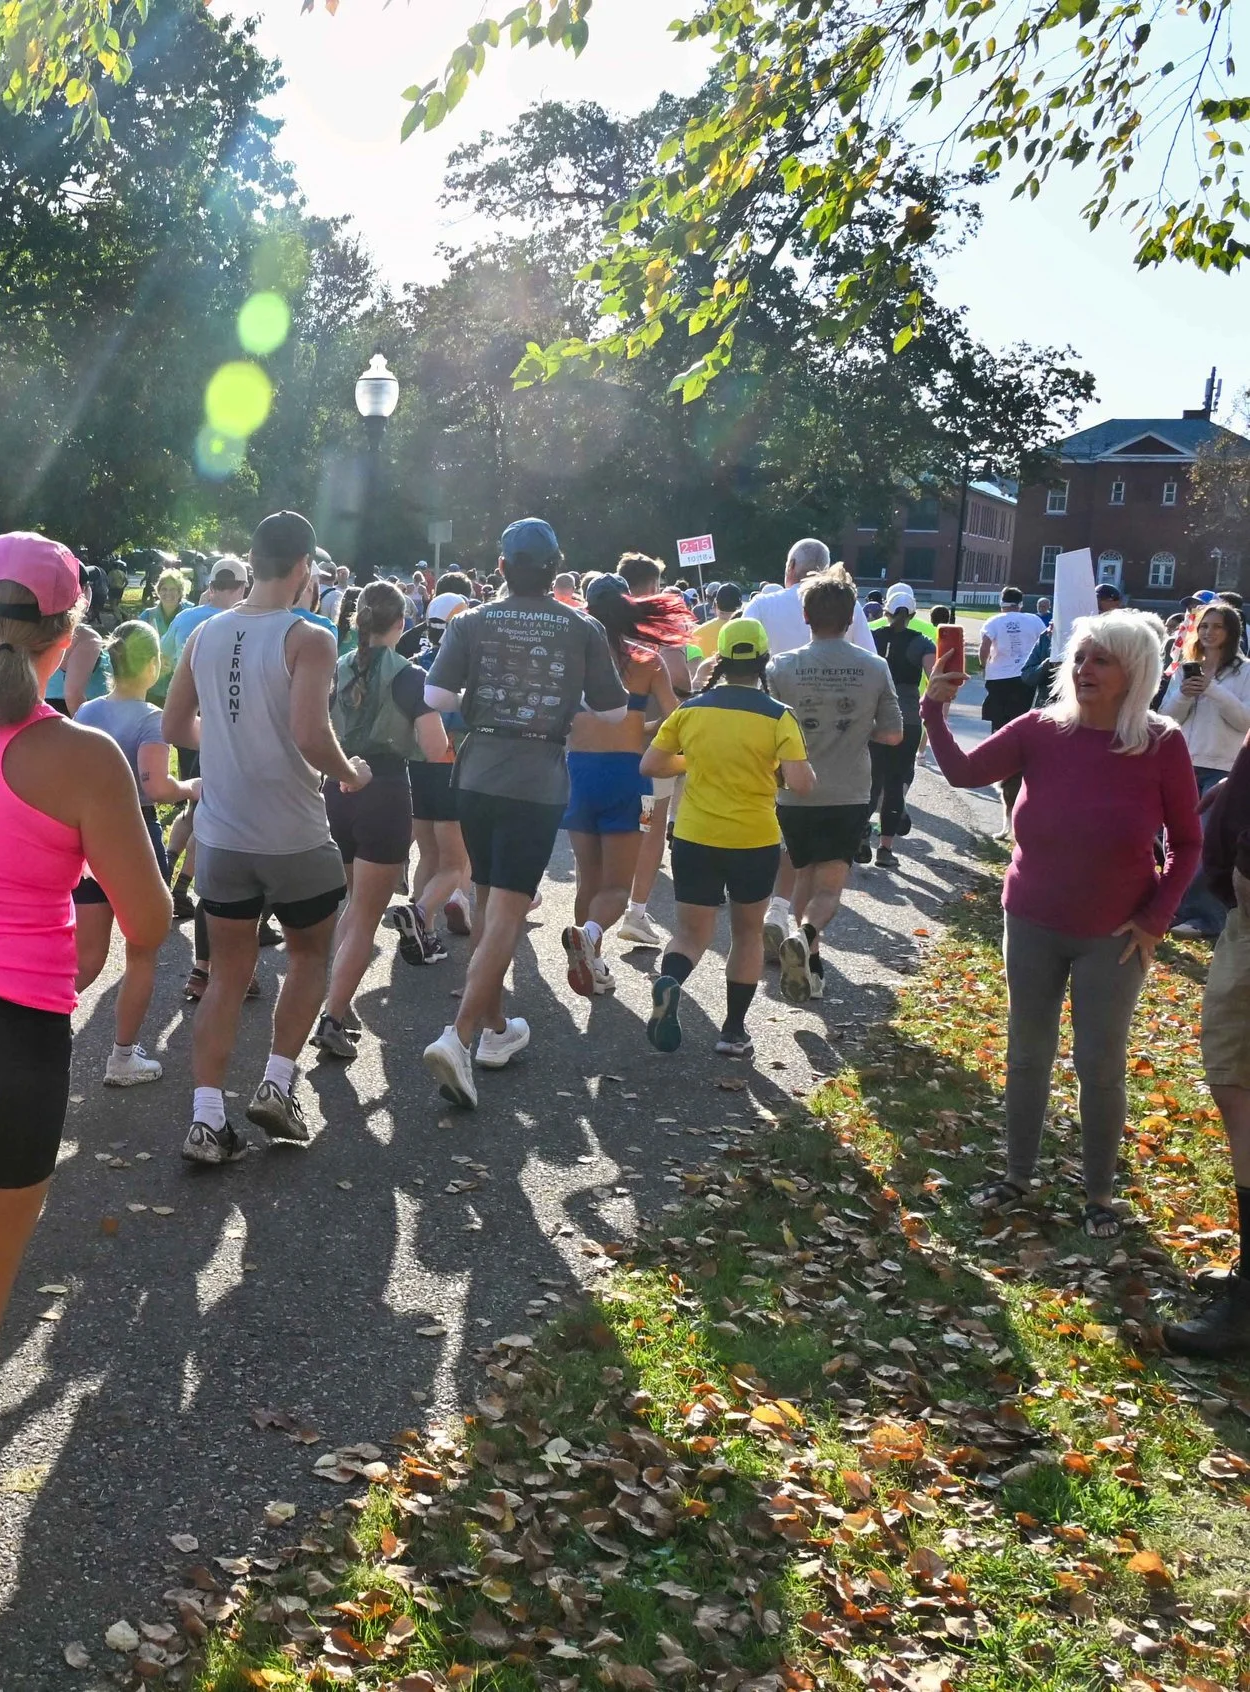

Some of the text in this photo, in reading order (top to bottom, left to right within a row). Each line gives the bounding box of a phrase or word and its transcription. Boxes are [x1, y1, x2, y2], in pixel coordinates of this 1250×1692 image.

[681, 539, 710, 553] 2:15
[486, 610, 570, 625] RIDGE RAMBLER
[513, 620, 569, 633] MARATHON
[509, 635, 541, 643] SPONSORS
[228, 631, 246, 723] VERMONT
